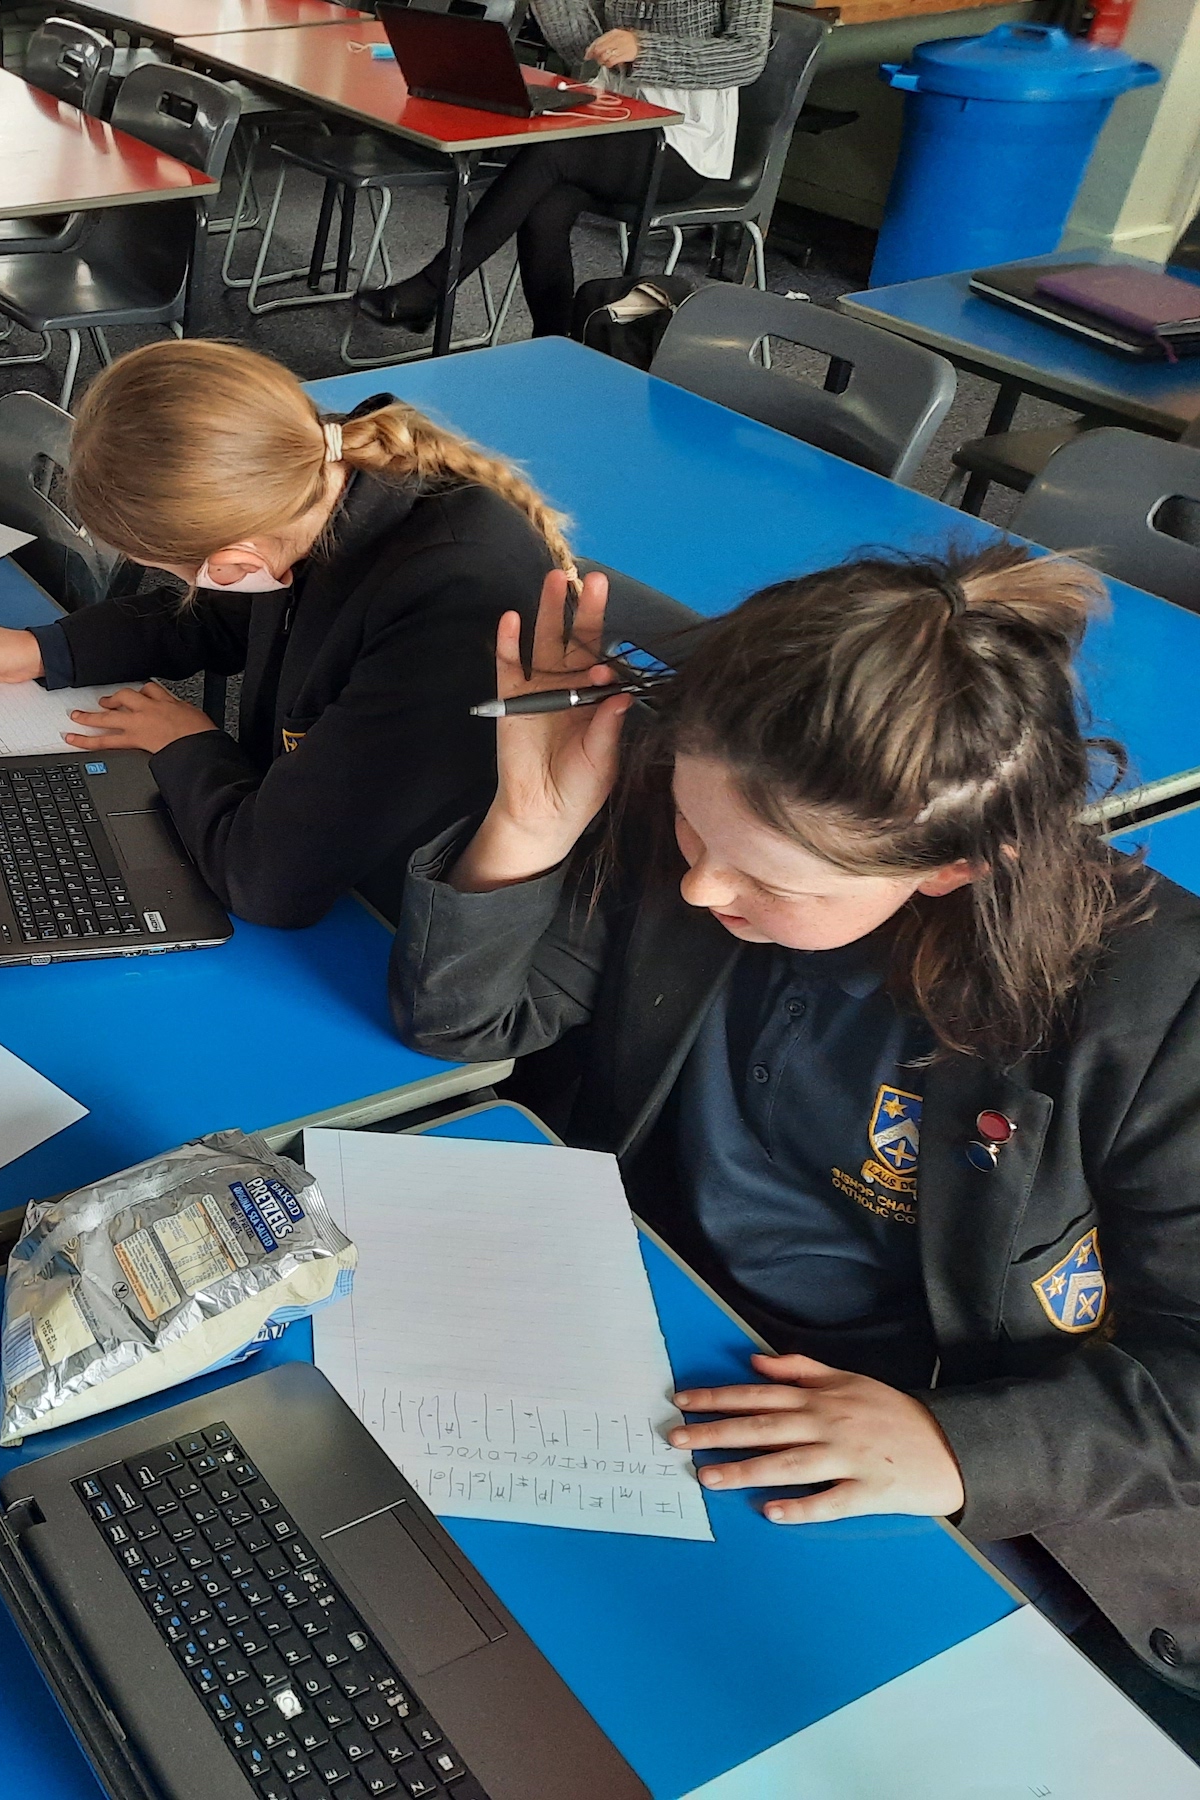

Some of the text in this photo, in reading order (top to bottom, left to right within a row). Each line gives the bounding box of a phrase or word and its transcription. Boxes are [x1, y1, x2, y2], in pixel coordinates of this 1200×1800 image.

[270, 1182, 301, 1216] BAKED
[831, 1177, 890, 1218] CATHOLIC
[246, 1177, 293, 1239] PRETZELS
[233, 1186, 273, 1247] ORIGINAL SEA SALTED
[44, 1319, 54, 1335] DEC
[190, 1558, 201, 1566] P
[231, 1567, 241, 1575] L
[206, 1582, 219, 1593] O
[247, 1592, 260, 1602] K
[283, 1591, 298, 1604] M
[303, 1622, 318, 1634] N
[243, 1641, 257, 1652] U
[285, 1650, 300, 1662] H
[325, 1653, 338, 1663] B
[263, 1673, 275, 1682] Y
[305, 1680, 319, 1692] G
[344, 1684, 357, 1694] V
[327, 1714, 340, 1724] F
[366, 1713, 380, 1725] C
[304, 1734, 317, 1746] R
[348, 1745, 362, 1757] D
[387, 1746, 402, 1759] X
[324, 1768, 339, 1780] E
[370, 1780, 384, 1790] S
[410, 1780, 426, 1793] Z
